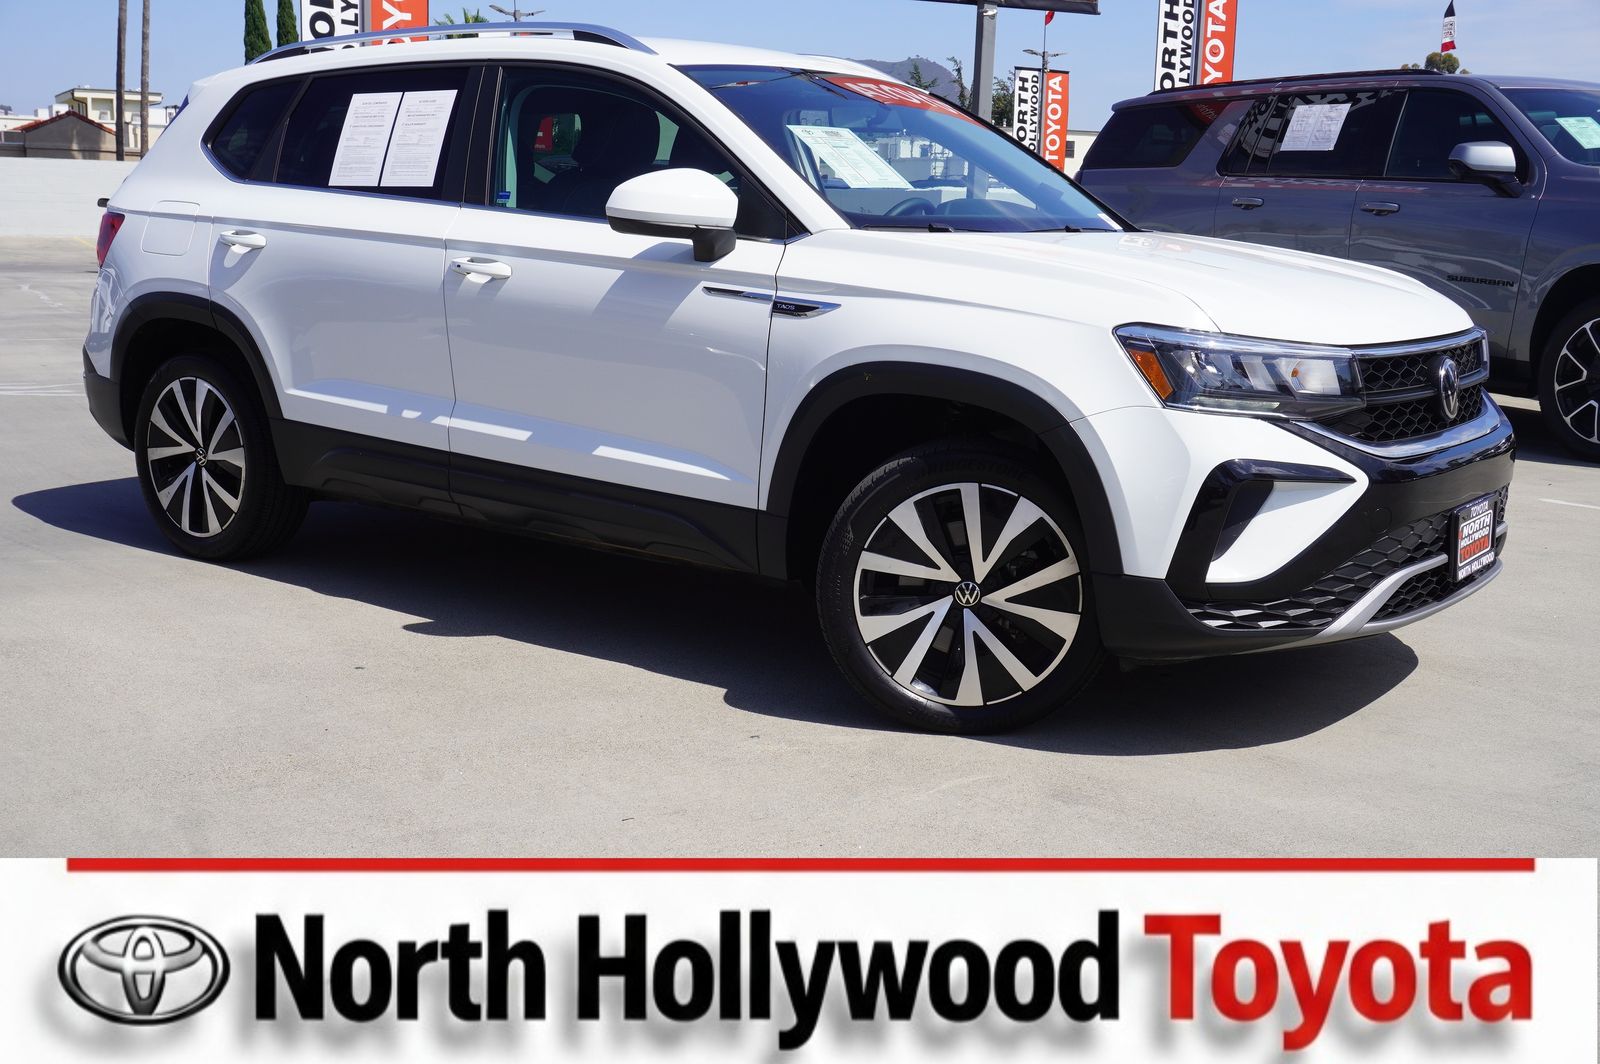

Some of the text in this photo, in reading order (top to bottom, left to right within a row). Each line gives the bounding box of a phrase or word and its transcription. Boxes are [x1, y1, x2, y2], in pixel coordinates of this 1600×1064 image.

[1159, 0, 1180, 90] ORTH
[1203, 0, 1227, 85] YOTA
[1016, 76, 1029, 143] ORTH
[1028, 74, 1039, 152] OLLYWOOD
[1045, 75, 1062, 161] TOYOTA
[1446, 274, 1515, 288] SUBURBAN
[776, 303, 796, 311] TAOS
[1470, 501, 1489, 517] TOYOTA
[1460, 526, 1490, 548] HOLLYWOOD
[1462, 513, 1491, 538] NORTH
[1459, 537, 1489, 562] TOYOTA
[1458, 551, 1495, 580] NORTH HOLLYWOOD
